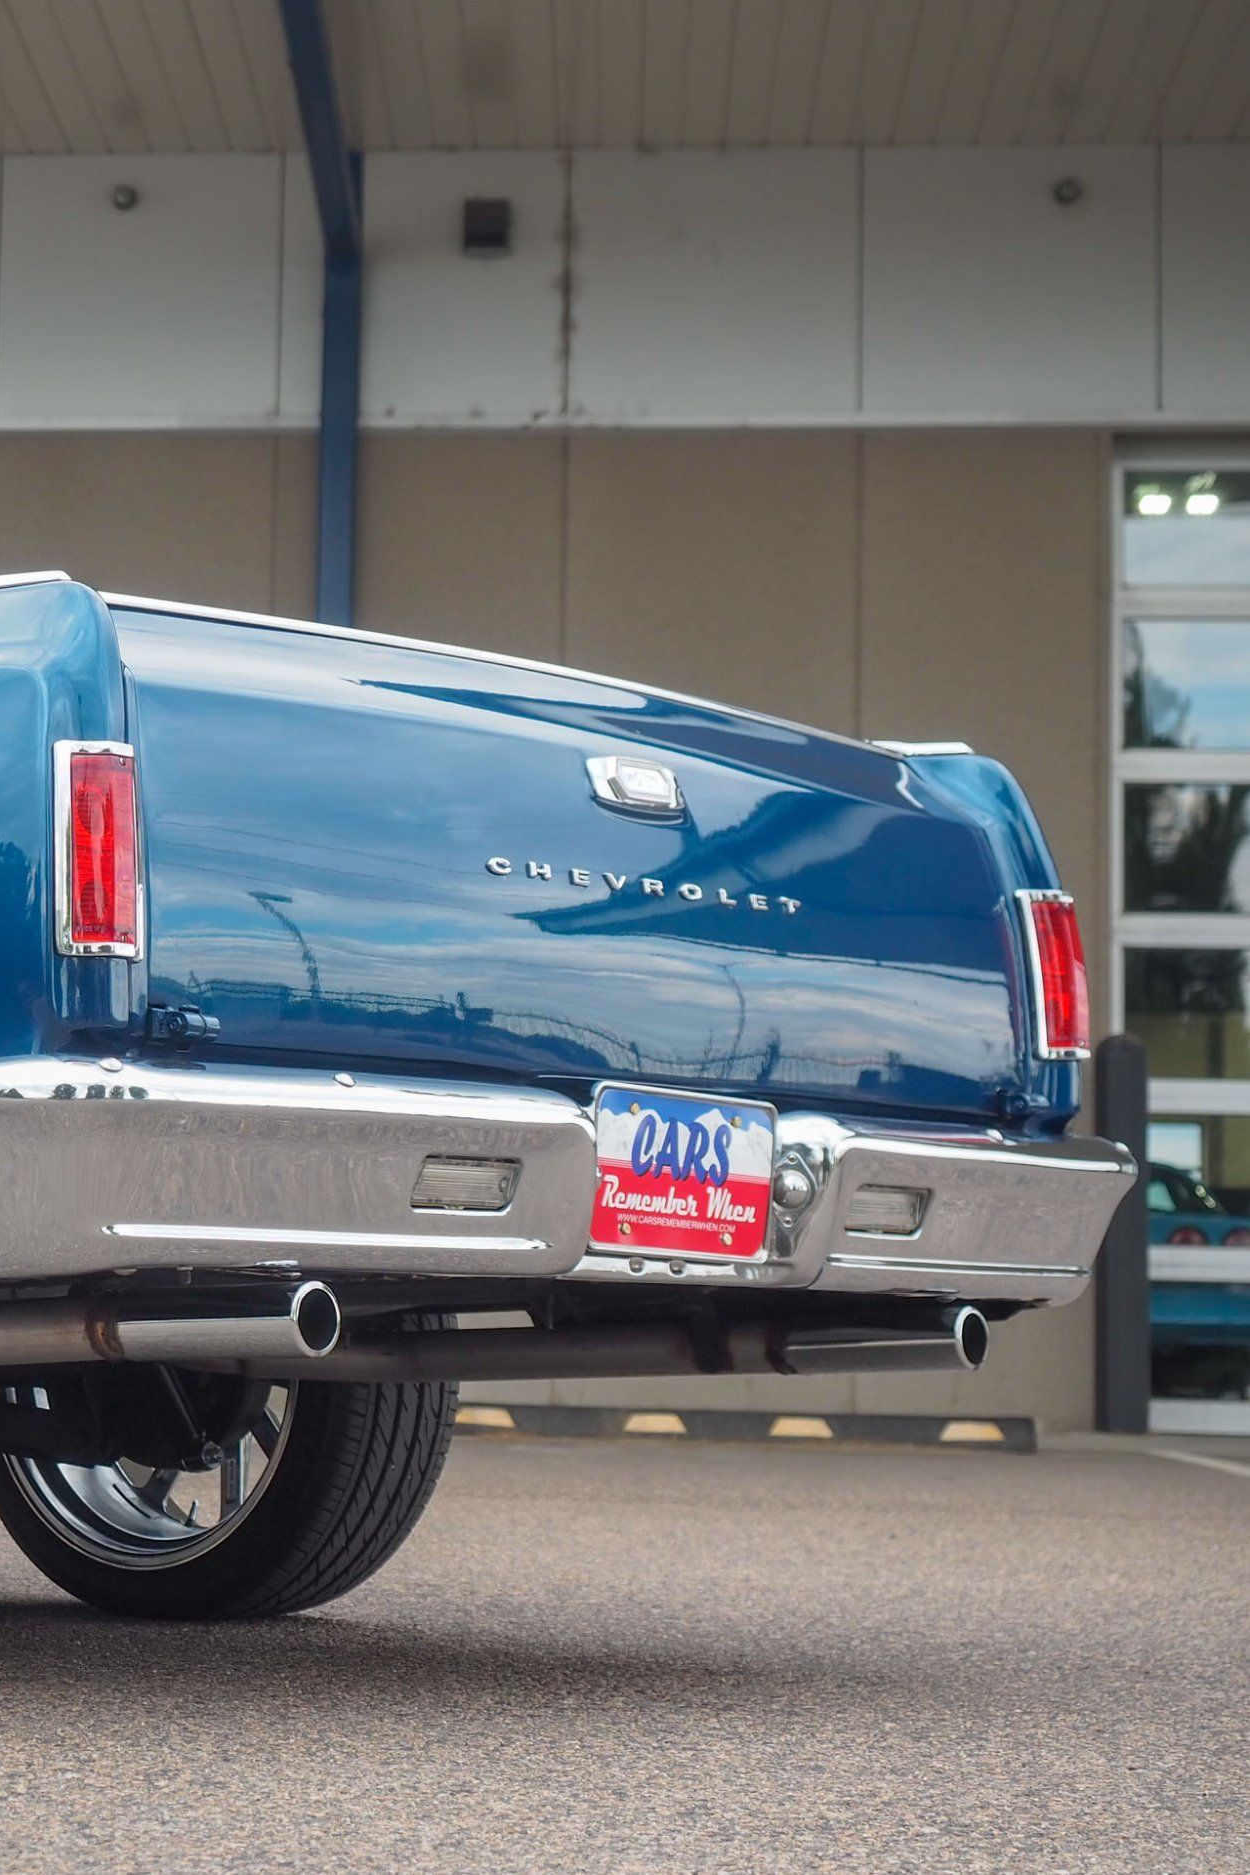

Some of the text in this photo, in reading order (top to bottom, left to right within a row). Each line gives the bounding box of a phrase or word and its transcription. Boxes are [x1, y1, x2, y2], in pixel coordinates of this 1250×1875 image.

[486, 856, 801, 914] CHEVROLET
[631, 1114, 732, 1187] CARS
[601, 1175, 756, 1223] Remember When
[617, 1213, 736, 1234] WWW.CARSREMEMBERWHEN.COM
